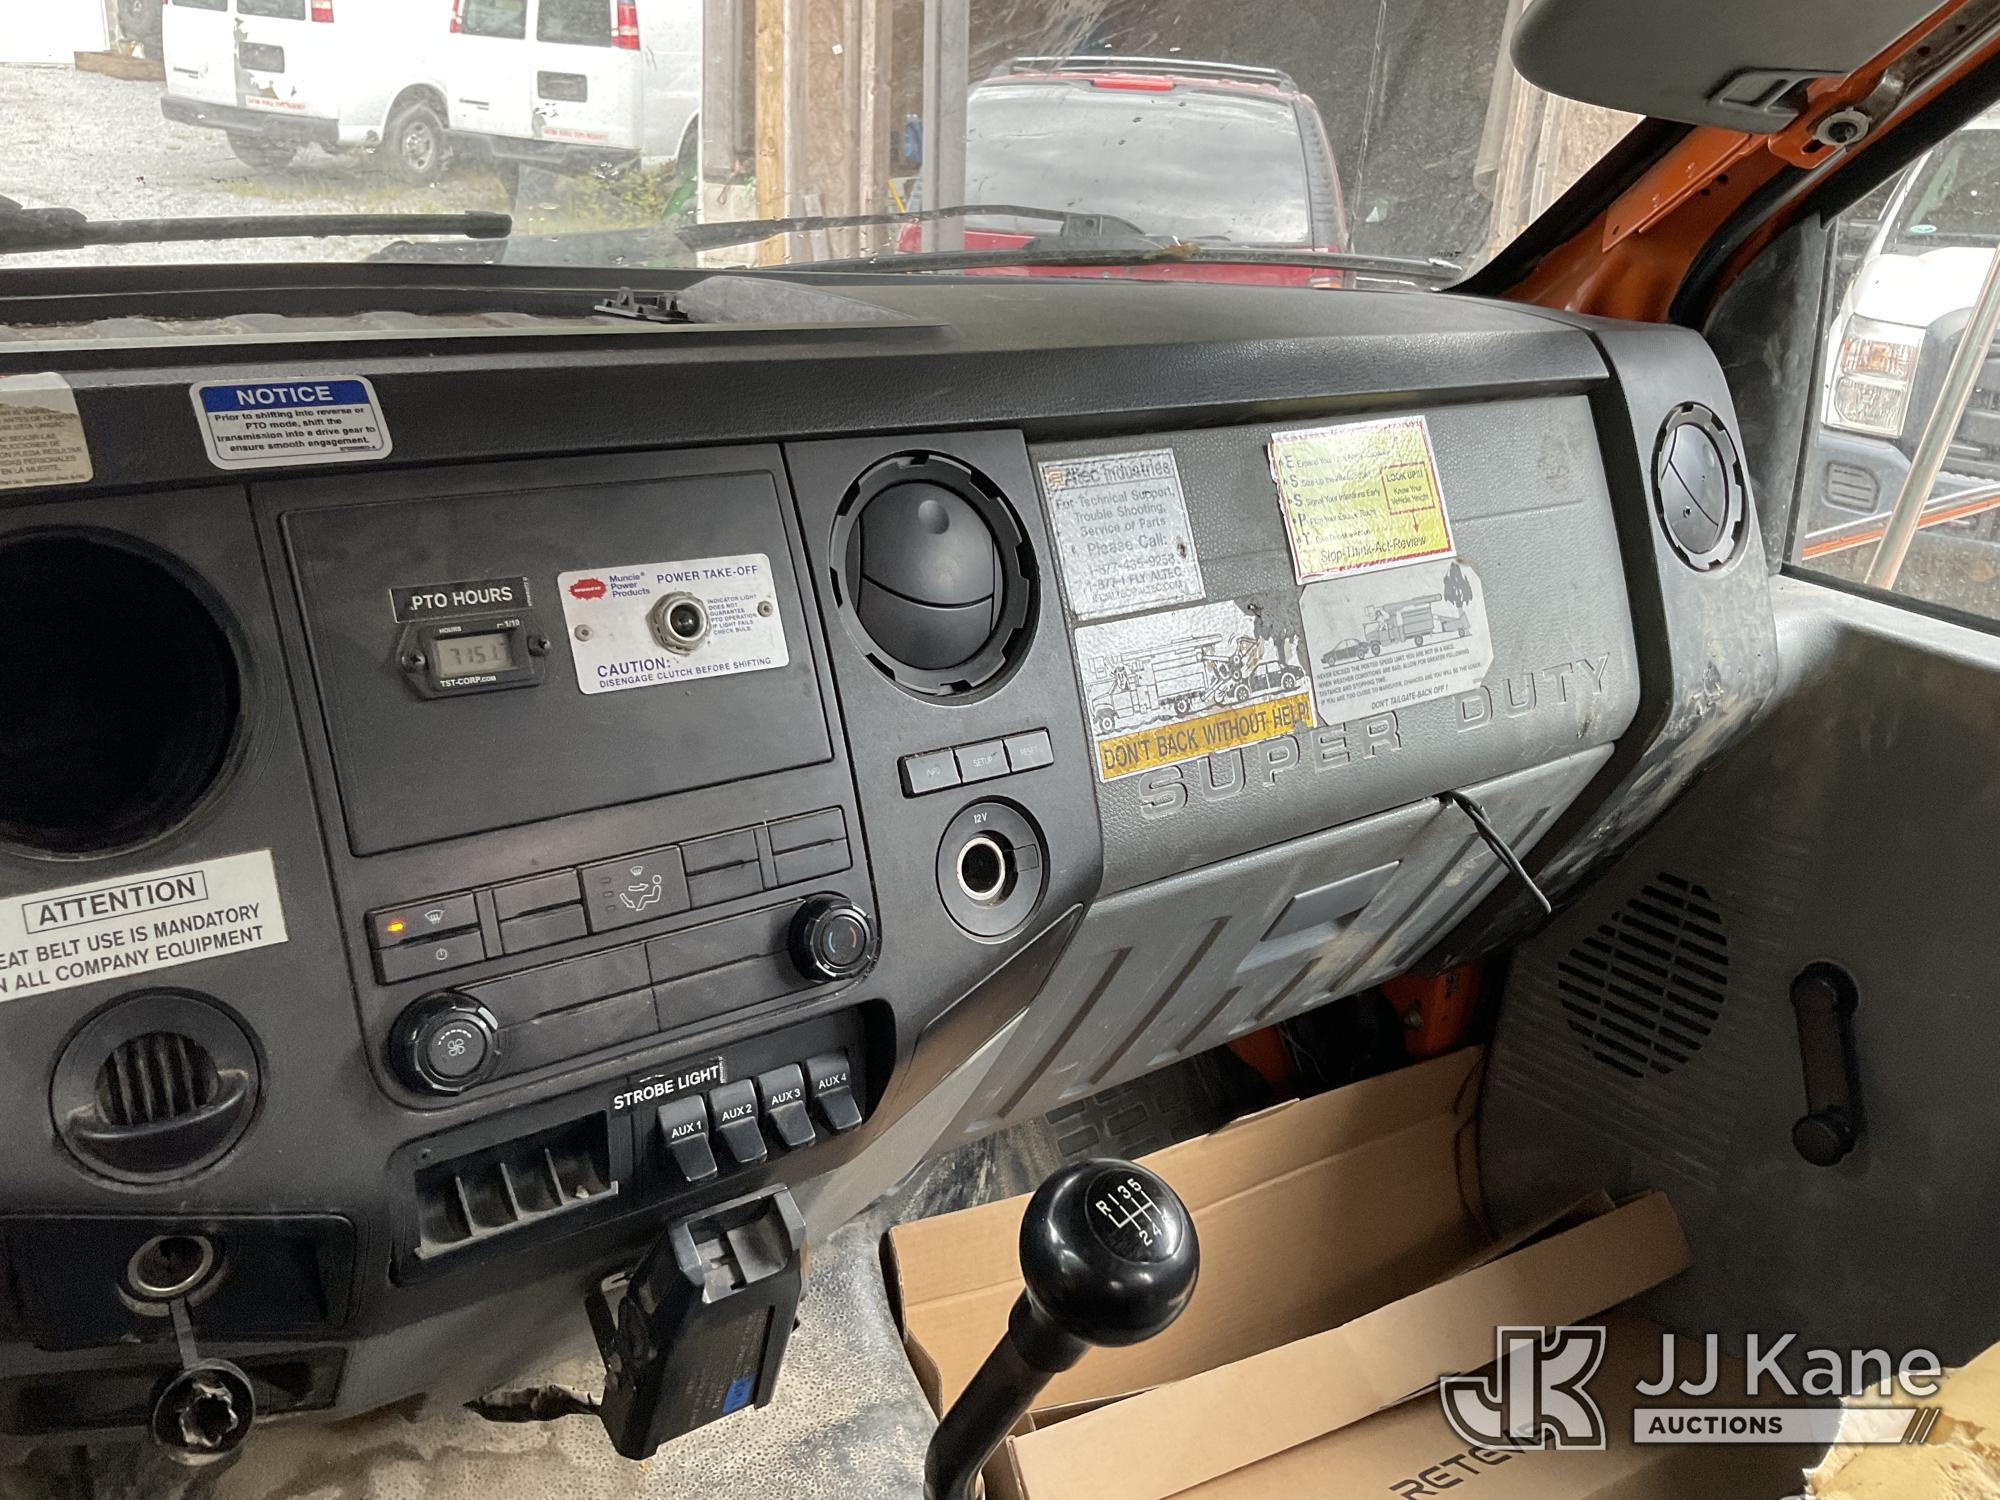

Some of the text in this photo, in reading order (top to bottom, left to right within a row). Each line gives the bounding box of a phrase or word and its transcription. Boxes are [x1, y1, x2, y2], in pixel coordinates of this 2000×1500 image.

[236, 386, 333, 405] NOTICE
[214, 413, 239, 421] Prior
[242, 412, 253, 420] to
[255, 410, 293, 420] shifting
[295, 409, 314, 417] into
[246, 421, 267, 430] PTO
[303, 418, 325, 426] shift
[327, 417, 342, 425] the
[217, 431, 282, 442] transmission
[285, 430, 304, 438] into
[316, 427, 340, 436] drive
[342, 427, 363, 436] gear
[365, 425, 376, 433] to
[230, 436, 369, 452] ensure smooth engagement.
[1102, 458, 1172, 483] Industries
[1285, 455, 1295, 468] E
[1290, 474, 1299, 488] S
[1386, 472, 1406, 482] LOOK
[1056, 498, 1074, 510] For
[1078, 490, 1128, 508] Technical
[1294, 494, 1303, 507] S
[1074, 508, 1113, 524] Trouble
[1298, 512, 1306, 526] P
[1080, 521, 1121, 538] Service
[1139, 515, 1166, 528] Parts
[1087, 532, 1167, 557] Please Call:
[609, 565, 758, 584] Muncie POWER TAKE-OFF
[1151, 565, 1182, 580] ALTEC
[611, 581, 638, 590] Power
[612, 588, 651, 598] Products
[411, 593, 448, 611] PTO
[452, 587, 513, 606] HOURS
[504, 619, 520, 628] 1/10
[597, 656, 671, 678] CAUTION:
[600, 656, 772, 688] DISENGAGE CLUTCH BEFORE SHIFTING
[440, 676, 497, 687] TST-CORP.com
[1371, 698, 1389, 710] DON'T
[1434, 685, 1444, 694] OFF
[1103, 736, 1150, 771] DON'T
[1157, 727, 1199, 757] BACK
[1202, 712, 1267, 745] WITHOUT
[1138, 653, 1612, 820] SUPER DUTY
[973, 755, 993, 768] SETUP
[973, 812, 988, 824] 12V
[39, 876, 196, 926] ATTENTION
[37, 938, 80, 963] BELT
[87, 930, 125, 951] USE
[130, 926, 148, 944] IS
[154, 902, 260, 939] MANDATORY
[15, 970, 51, 991] ALL
[56, 948, 149, 981] COMPANY
[156, 925, 264, 961] EQUIPMENT
[613, 1065, 719, 1110] STROBE LIGHT
[818, 1072, 847, 1090] AUX 4
[771, 1088, 801, 1105] AUX 3
[722, 1103, 752, 1122] AUX 2
[671, 1120, 702, 1138] AUX 1
[1095, 1178, 1141, 1216] R 1 3 5
[1139, 1221, 1162, 1246] 2 4
